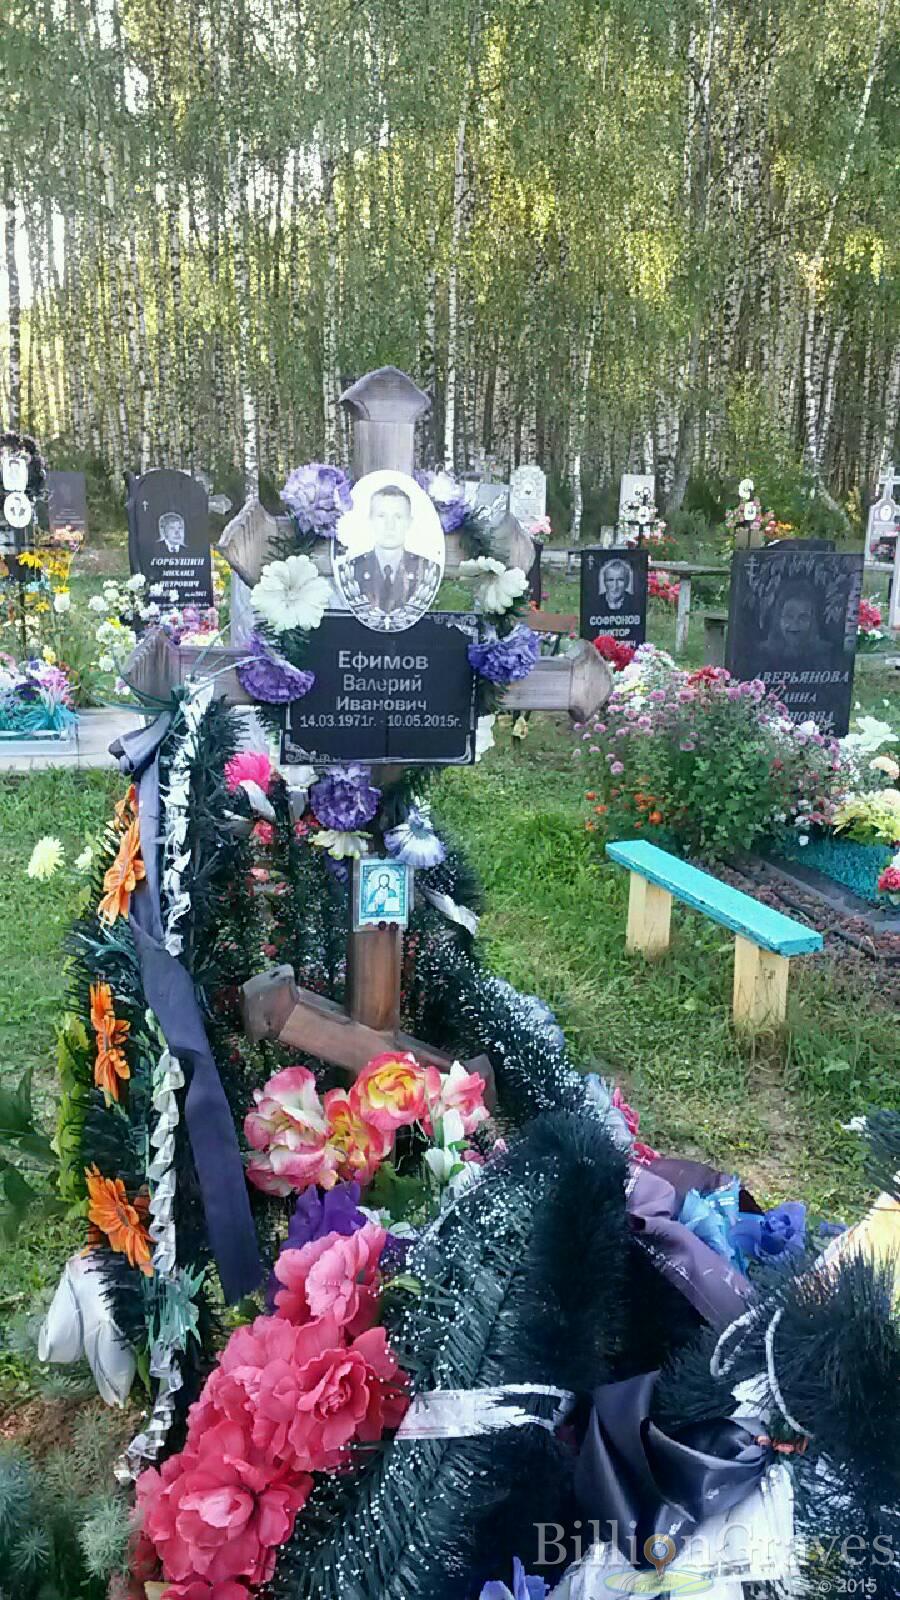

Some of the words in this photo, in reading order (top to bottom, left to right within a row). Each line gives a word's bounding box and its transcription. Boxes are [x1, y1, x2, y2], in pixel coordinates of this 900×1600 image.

[589, 615, 640, 626] СОФРОНОВ
[338, 650, 429, 672] Ефимов
[343, 673, 422, 695] Валерий
[336, 696, 427, 711] Иванович
[300, 714, 377, 728] 14.03.1971г.
[387, 714, 463, 727] 10.05.2015г.
